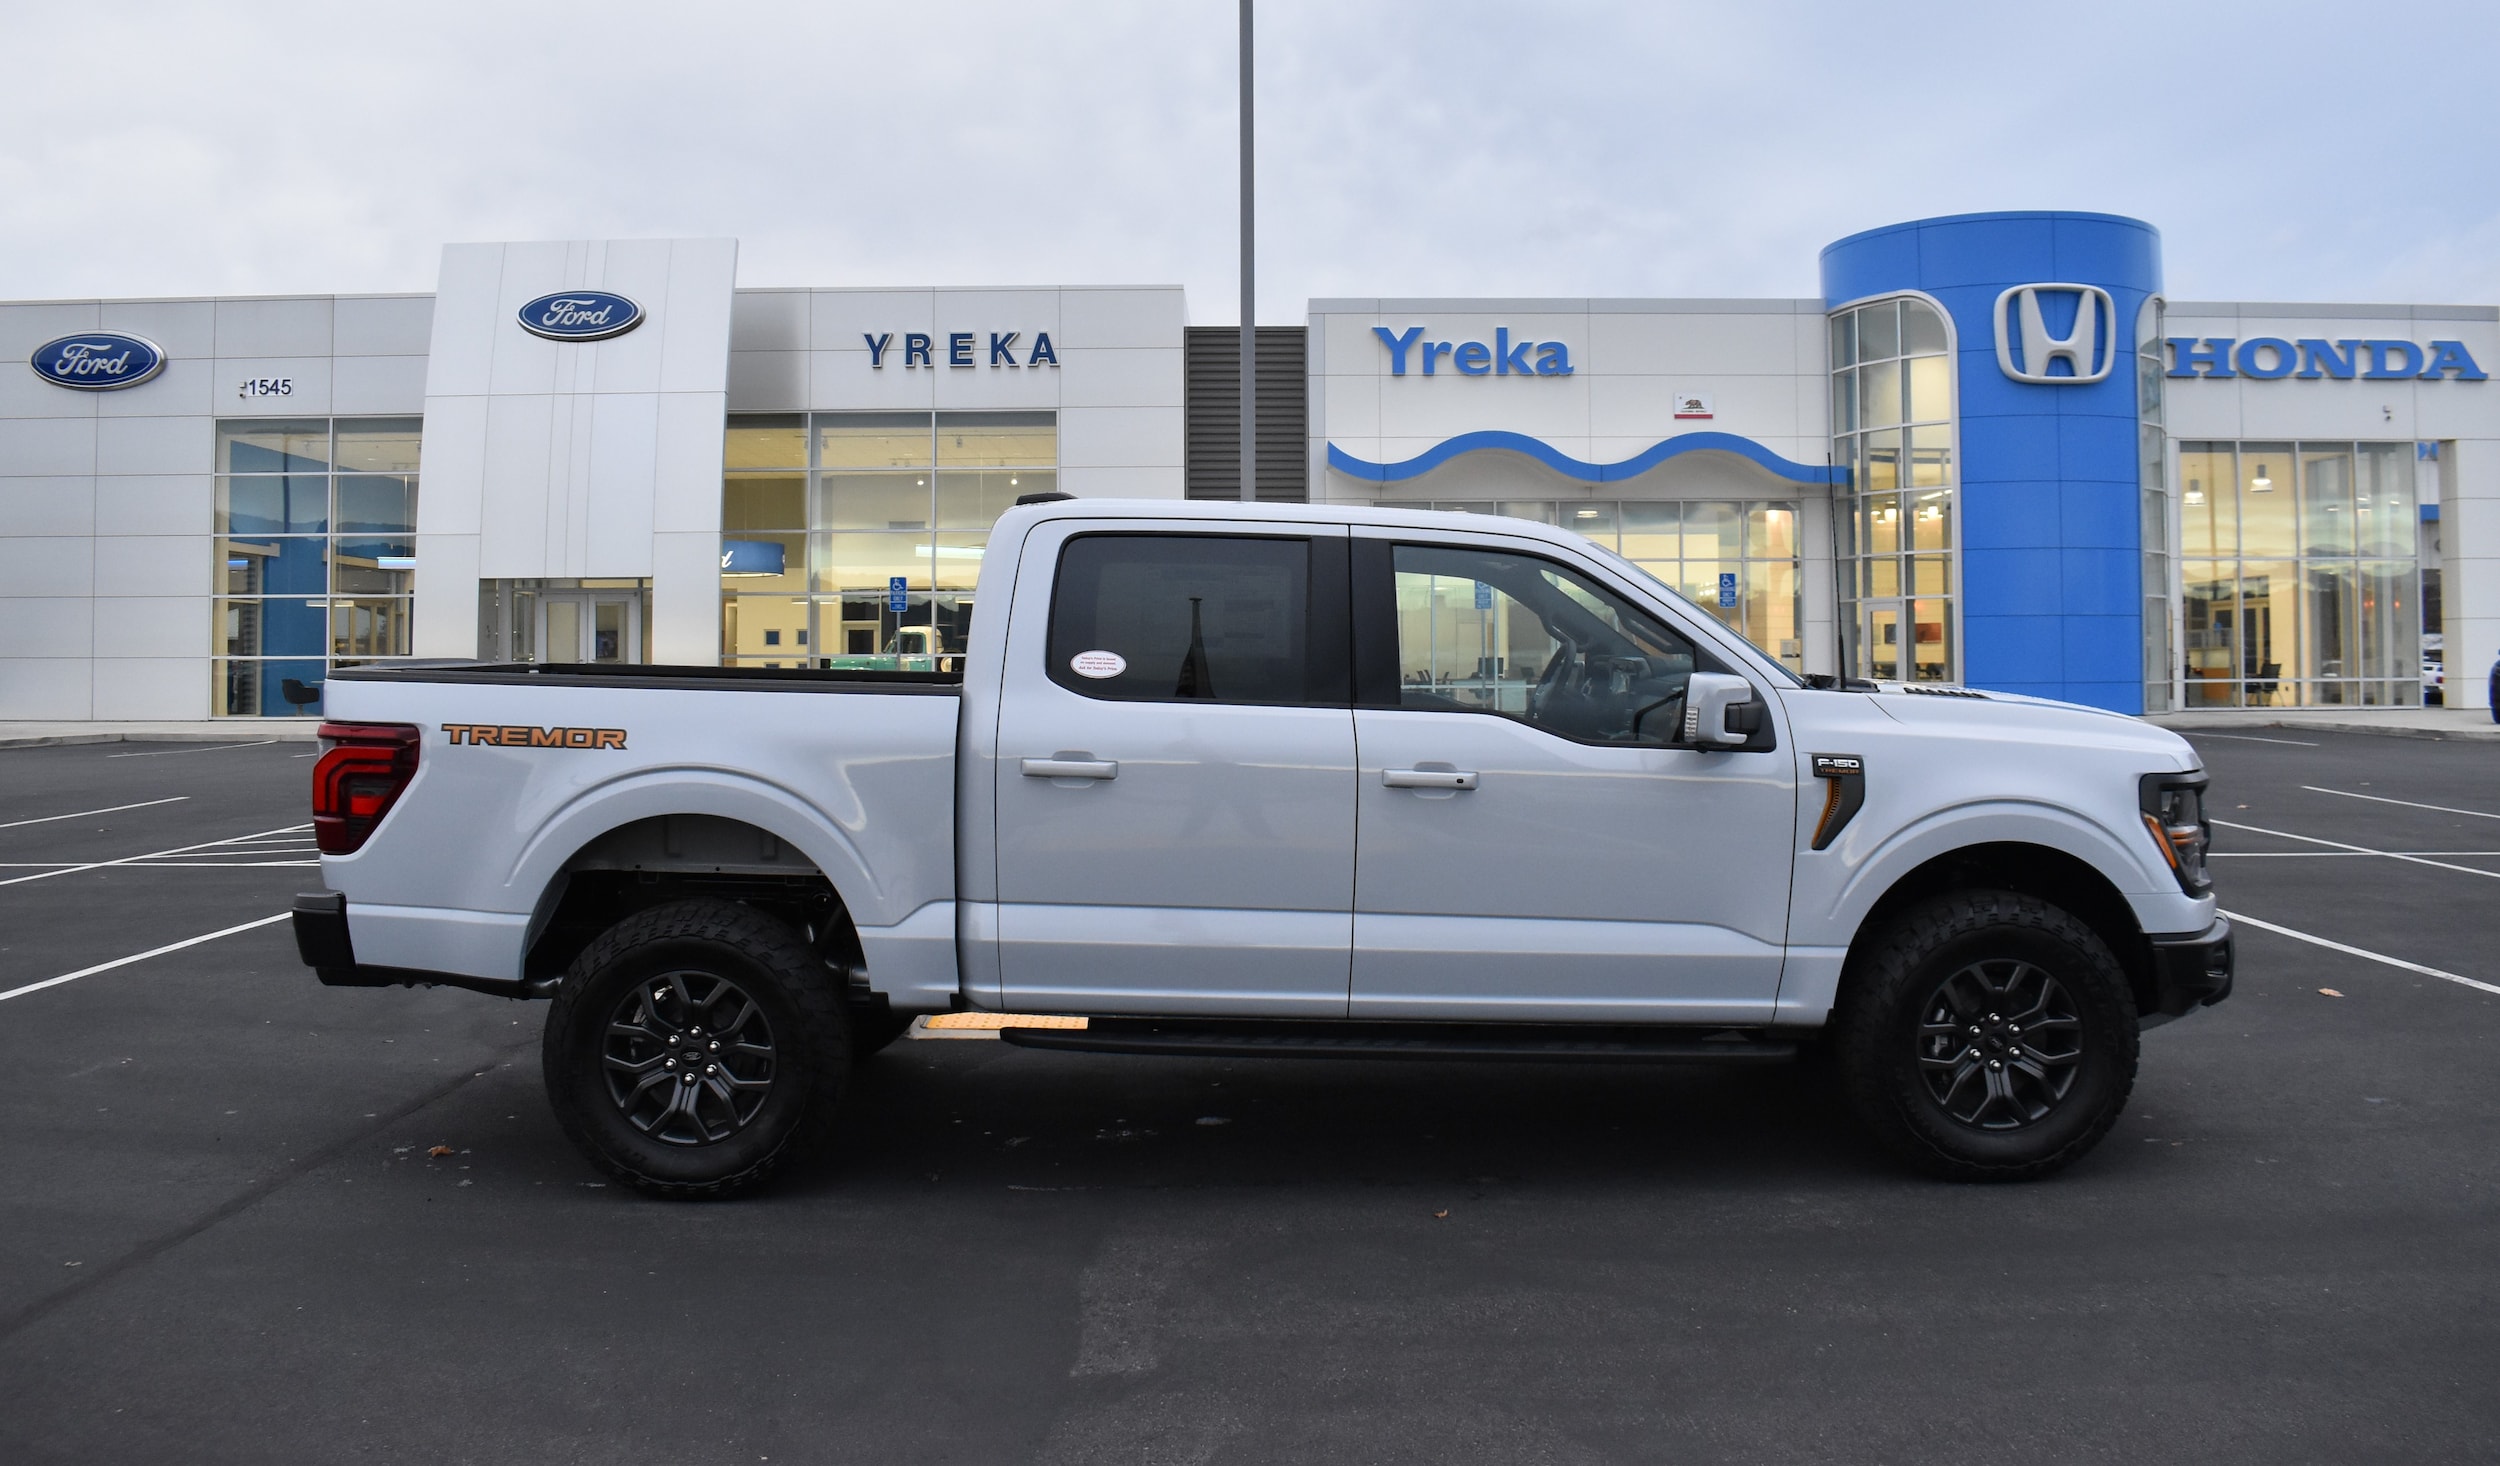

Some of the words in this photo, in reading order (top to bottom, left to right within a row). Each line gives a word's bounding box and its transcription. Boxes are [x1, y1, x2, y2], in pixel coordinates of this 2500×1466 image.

[542, 299, 613, 326] Ford
[55, 343, 131, 375] Ford
[862, 332, 1060, 368] YREKA
[1372, 326, 1575, 376] Yreka
[2165, 337, 2489, 380] HONDA
[248, 379, 292, 395] 1545
[441, 723, 628, 750] TREMOR
[1817, 758, 1860, 768] F-150
